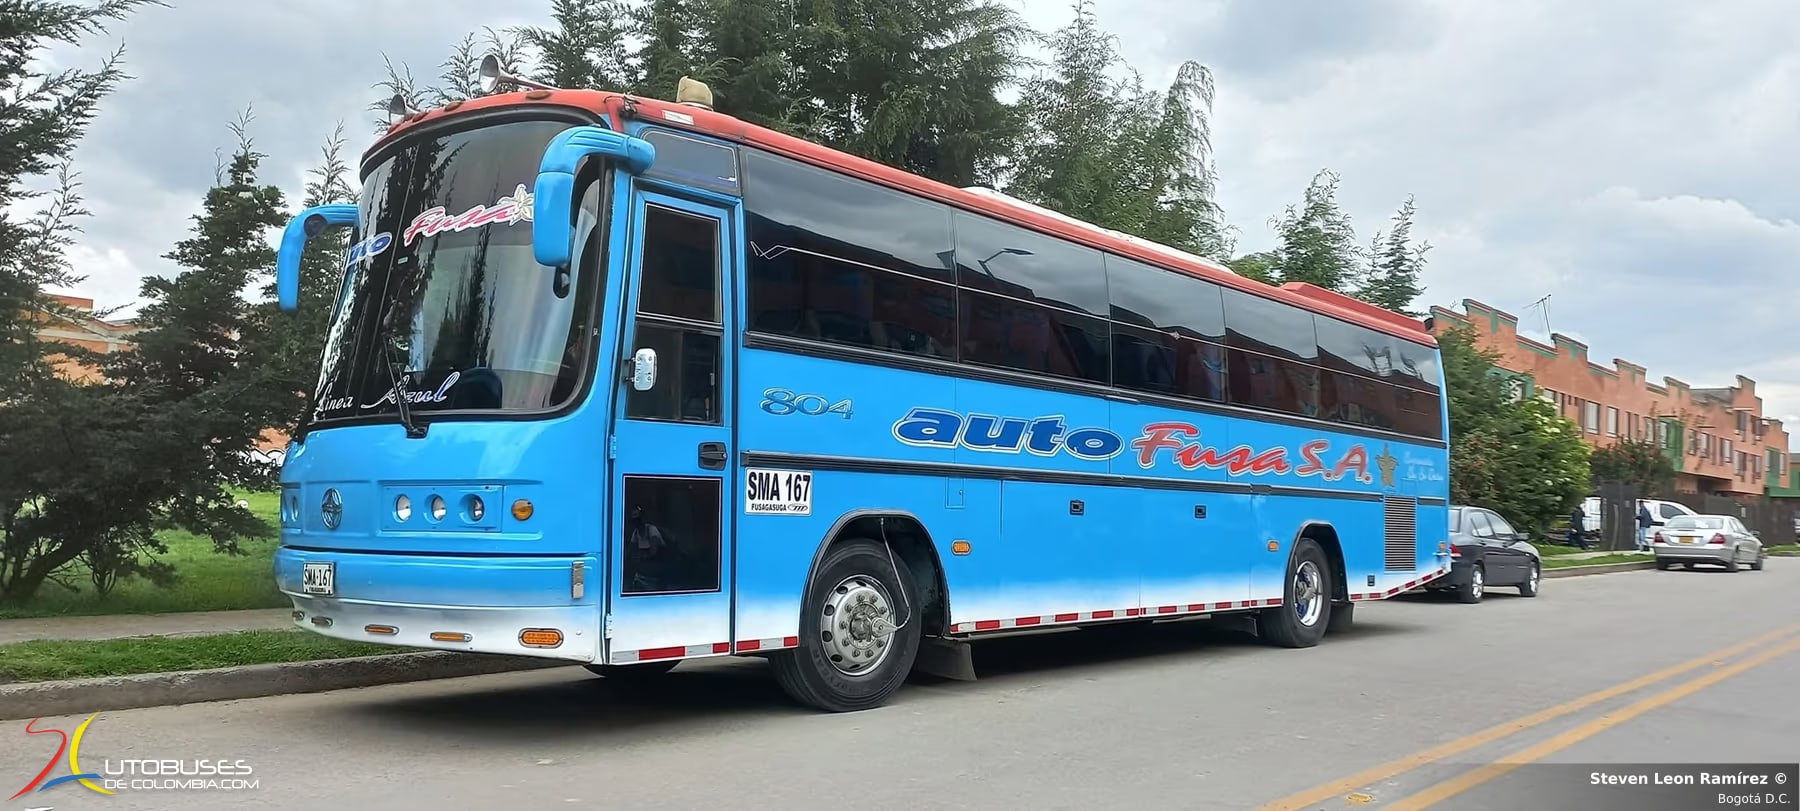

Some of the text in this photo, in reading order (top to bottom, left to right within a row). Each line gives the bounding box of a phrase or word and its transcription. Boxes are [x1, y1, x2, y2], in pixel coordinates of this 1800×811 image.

[759, 386, 853, 420] 804
[892, 407, 1373, 485] auto Fusa S.A.
[748, 471, 810, 502] SMA 167
[751, 503, 787, 511] FUSAGASUGA
